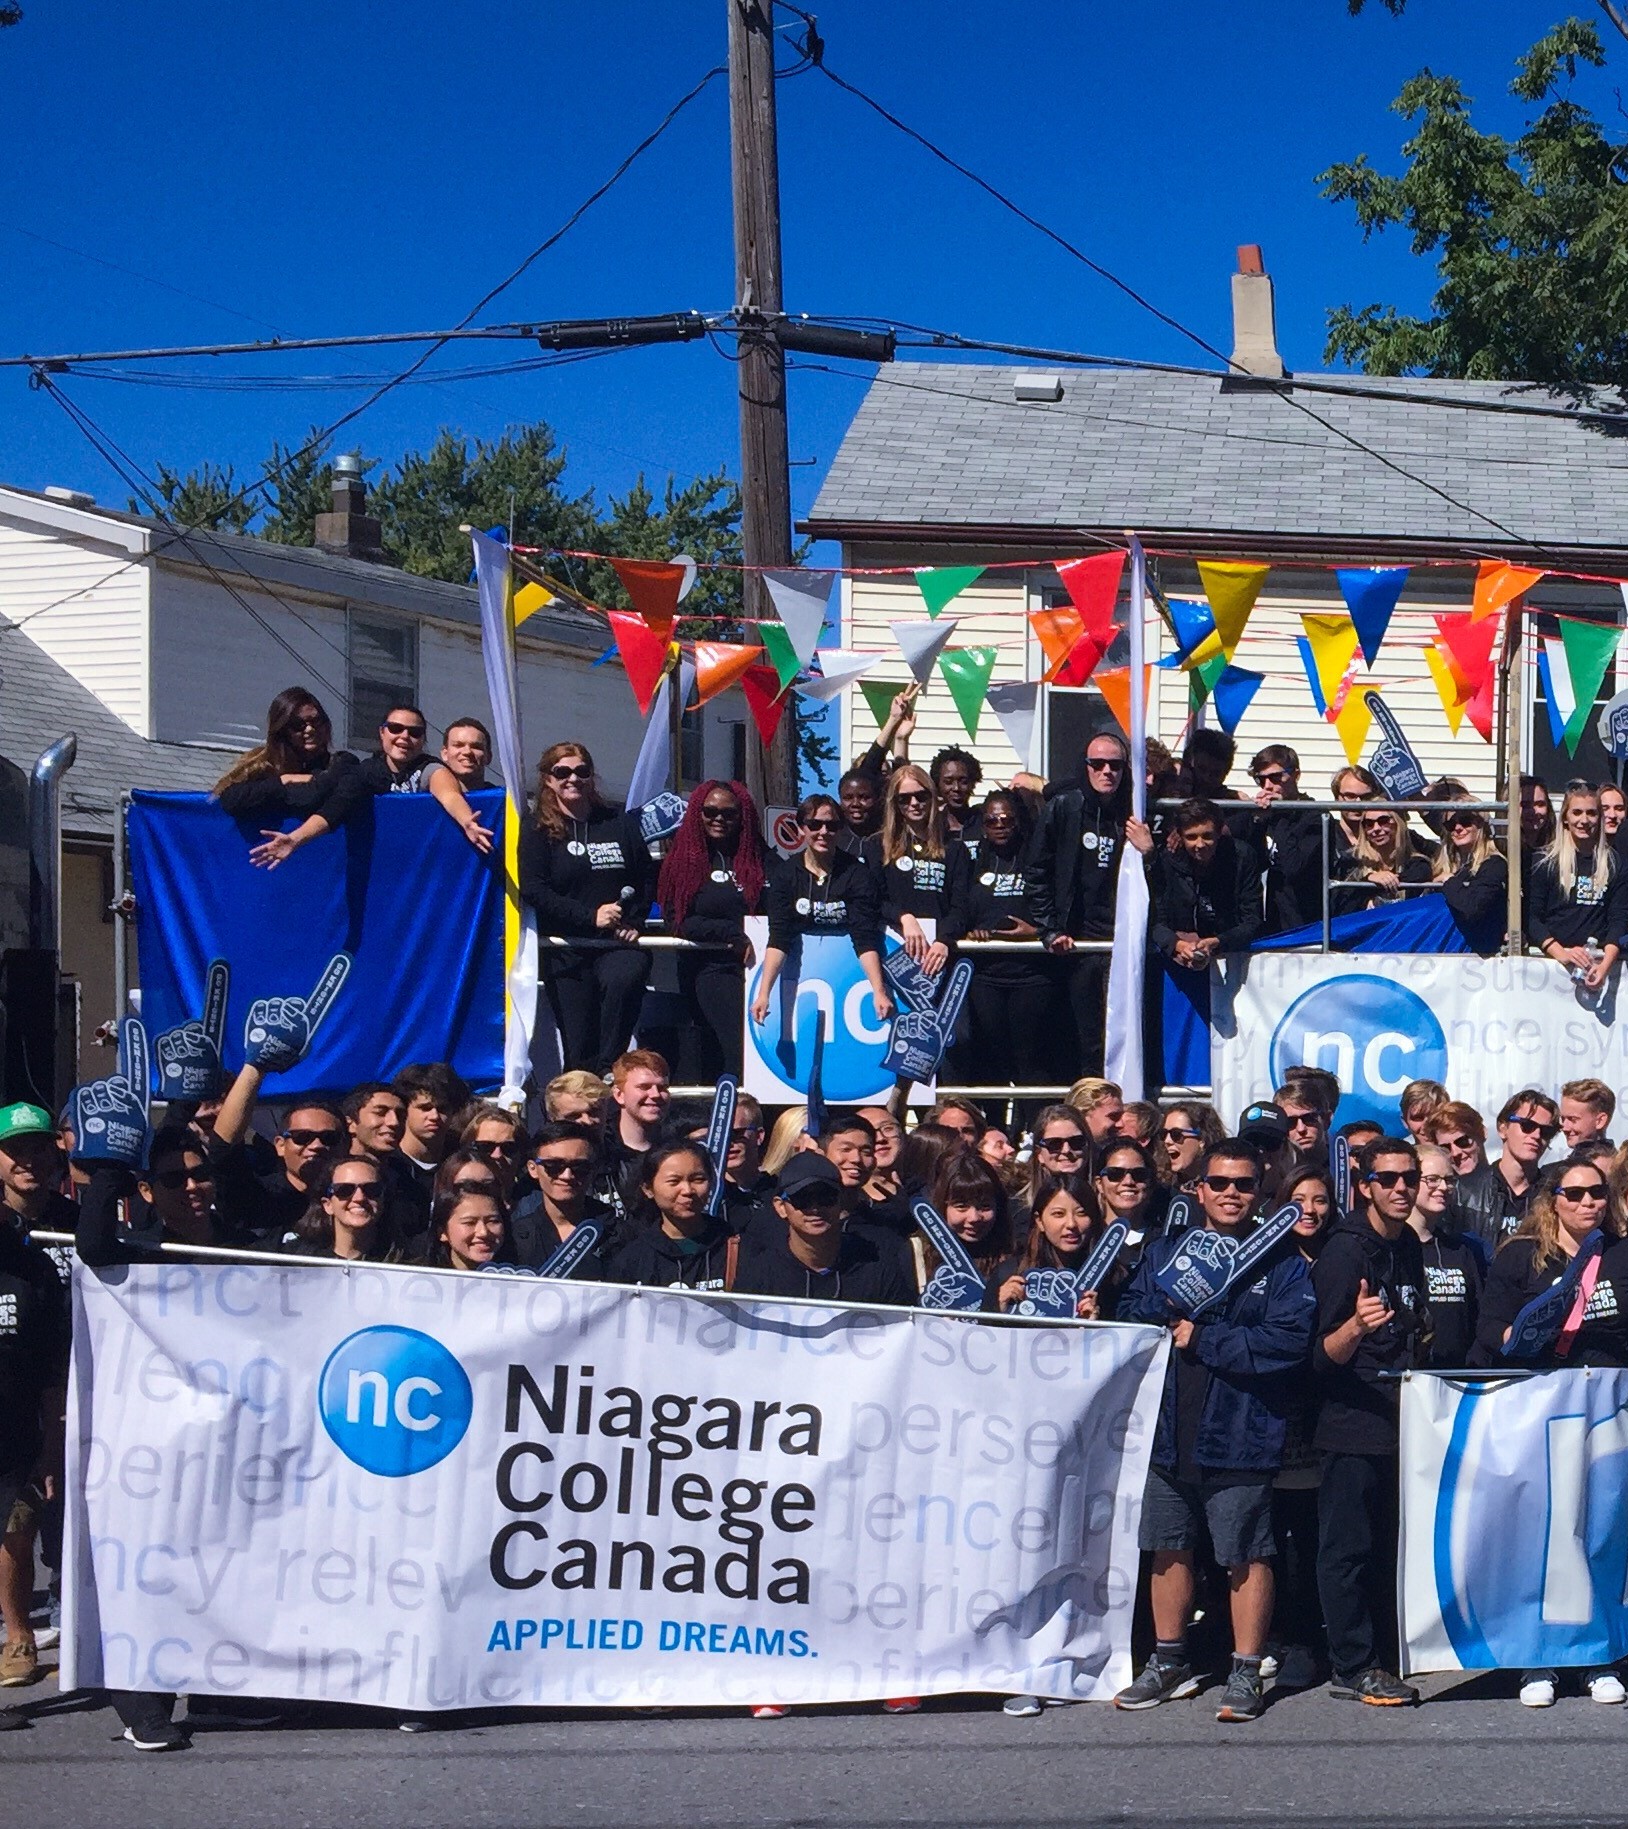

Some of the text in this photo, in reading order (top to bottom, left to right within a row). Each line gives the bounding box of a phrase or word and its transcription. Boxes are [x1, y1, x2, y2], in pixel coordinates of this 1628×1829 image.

[309, 976, 336, 1016] KNIGHTS
[793, 978, 892, 1045] nc
[909, 1046, 935, 1062] Niagara
[1302, 1027, 1417, 1098] nc
[107, 1121, 142, 1135] Niagara
[711, 1105, 726, 1154] KNIGHTS
[931, 1223, 963, 1269] KNIGHTS
[1238, 1224, 1280, 1261] KNIGHTS
[1078, 1245, 1112, 1291] KNIGHTS
[1182, 1271, 1208, 1300] College
[1189, 1265, 1214, 1294] Niagara
[1424, 1266, 1463, 1278] Niagara
[1428, 1275, 1466, 1286] College
[1022, 1303, 1033, 1312] nc
[1177, 1276, 1202, 1305] Canada
[1428, 1283, 1466, 1295] Canada
[347, 1366, 442, 1431] nc
[504, 1363, 824, 1460] Niagara
[495, 1441, 816, 1543] College
[489, 1521, 811, 1605] Canada
[487, 1619, 819, 1659] APPLIED DREAMS.
